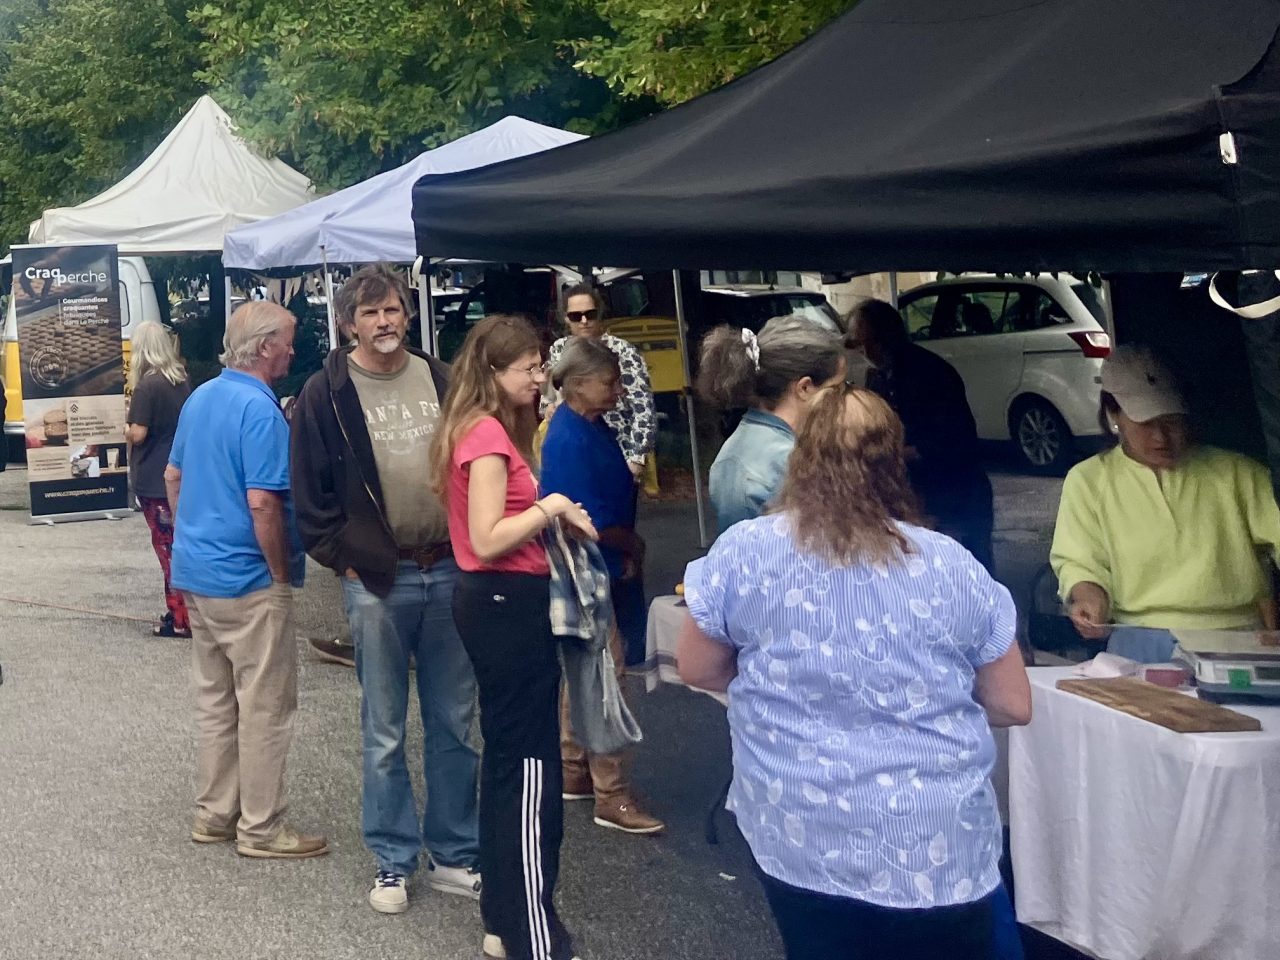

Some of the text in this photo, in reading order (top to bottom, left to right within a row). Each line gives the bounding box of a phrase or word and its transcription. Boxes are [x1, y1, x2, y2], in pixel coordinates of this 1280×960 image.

[62, 296, 108, 304] Gourmandises
[366, 403, 413, 424] ANTA
[373, 430, 394, 441] NEW
[399, 423, 435, 441] MEXICO
